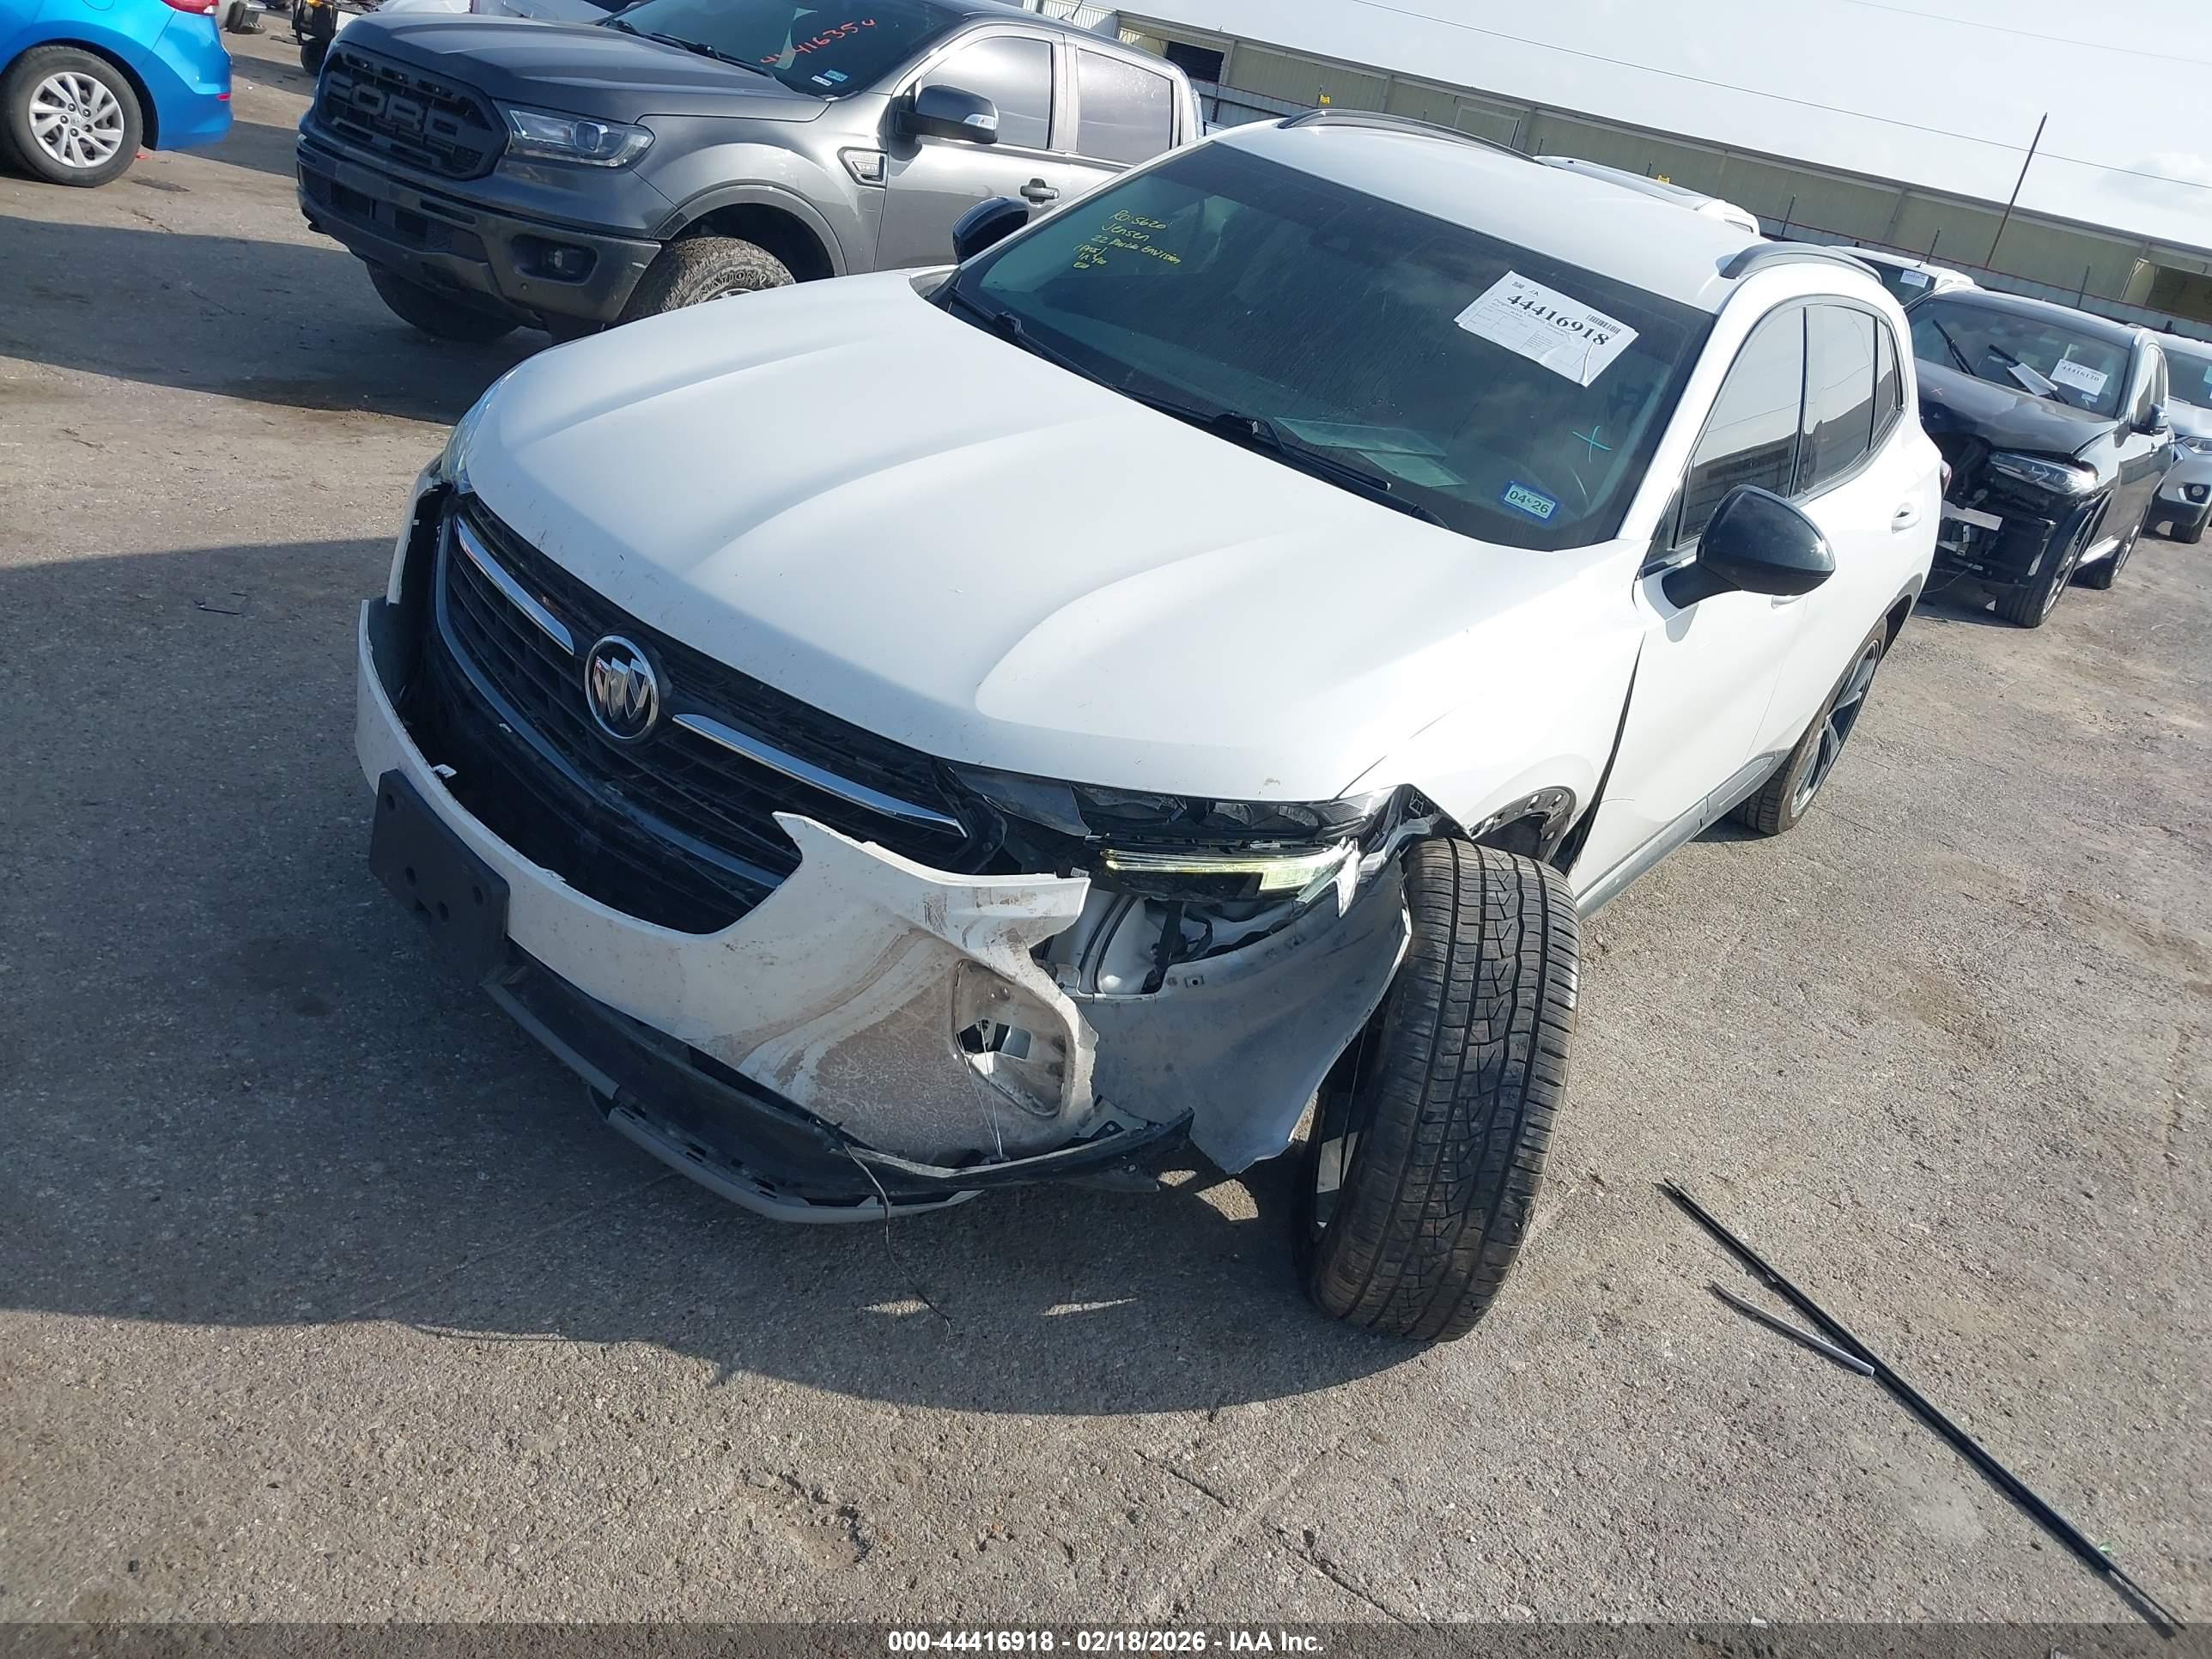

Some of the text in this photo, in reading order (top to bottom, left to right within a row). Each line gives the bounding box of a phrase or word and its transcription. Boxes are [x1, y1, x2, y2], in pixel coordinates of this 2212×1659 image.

[324, 69, 465, 143] FORD
[1091, 234, 1108, 245] 22
[1102, 222, 1151, 242] Jensen
[1507, 295, 1610, 345] 44416918
